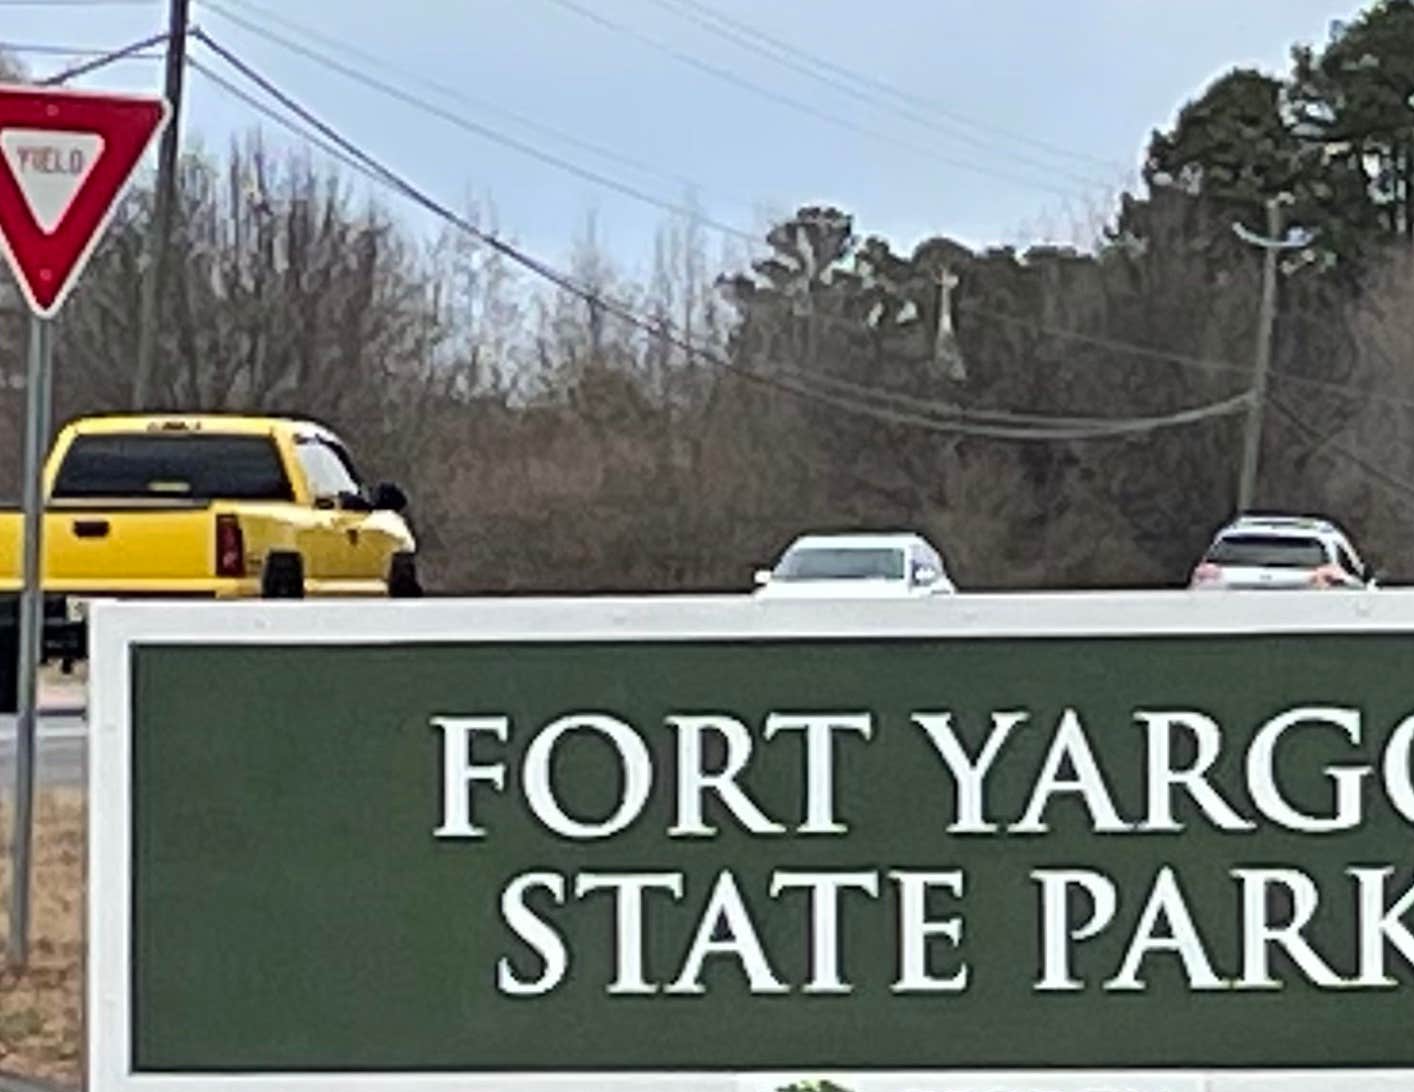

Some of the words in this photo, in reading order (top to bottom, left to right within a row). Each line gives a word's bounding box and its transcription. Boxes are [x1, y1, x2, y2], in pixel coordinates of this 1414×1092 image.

[17, 147, 83, 174] YIELD
[432, 713, 871, 837] FORT
[498, 871, 968, 994] STATE
